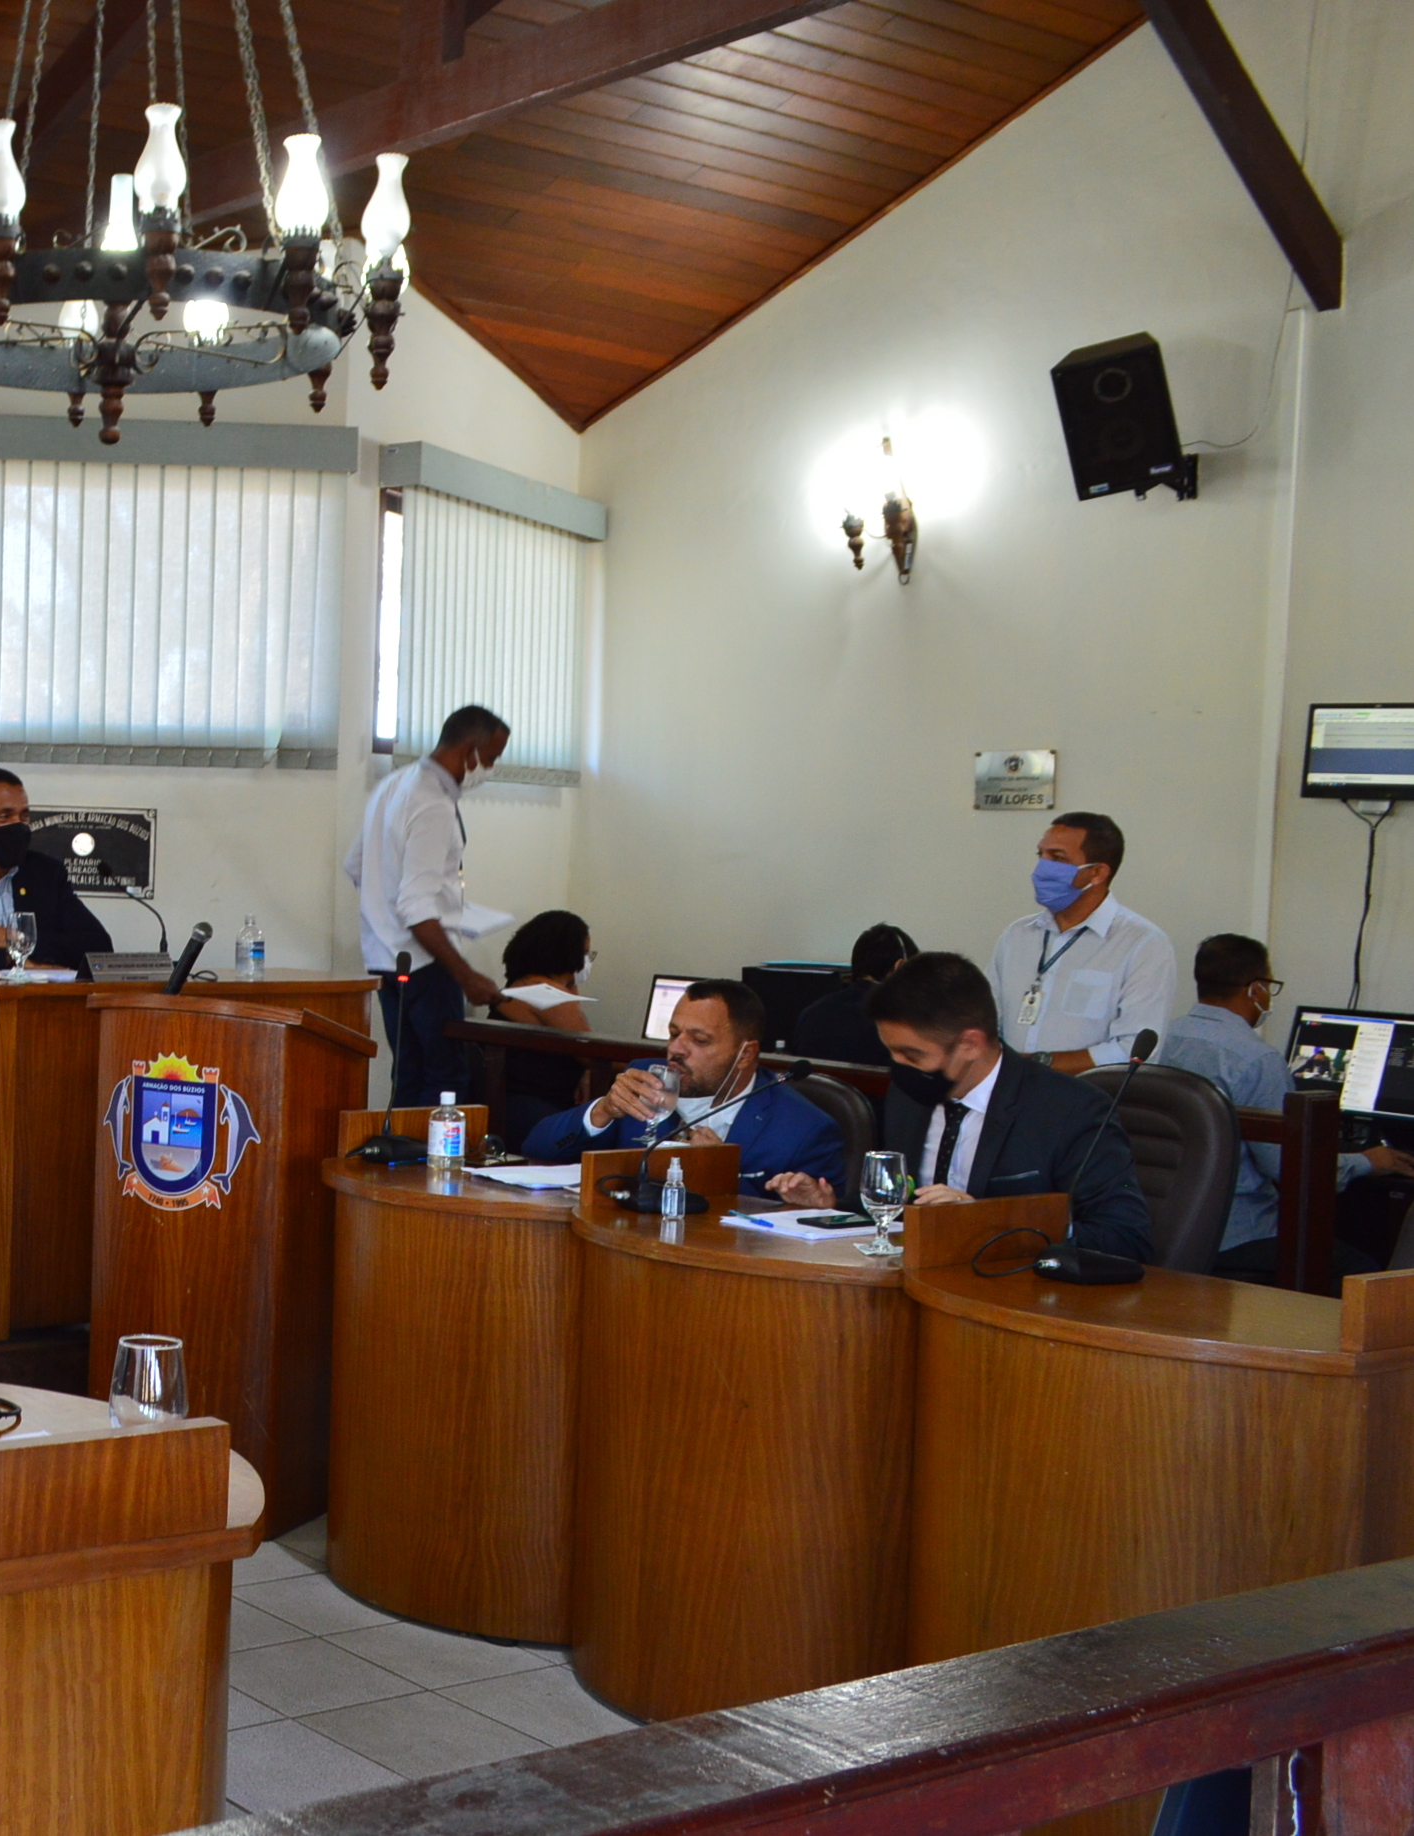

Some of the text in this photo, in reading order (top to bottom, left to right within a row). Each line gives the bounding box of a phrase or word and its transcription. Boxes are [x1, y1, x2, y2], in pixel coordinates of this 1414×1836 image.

[983, 794, 1044, 805] TIM LOPES
[44, 813, 76, 826] MUNICIPAL
[78, 811, 87, 822] DE
[116, 818, 130, 831] DOS
[142, 1081, 206, 1094] ARMAÇÃO DOS BÚZIOS
